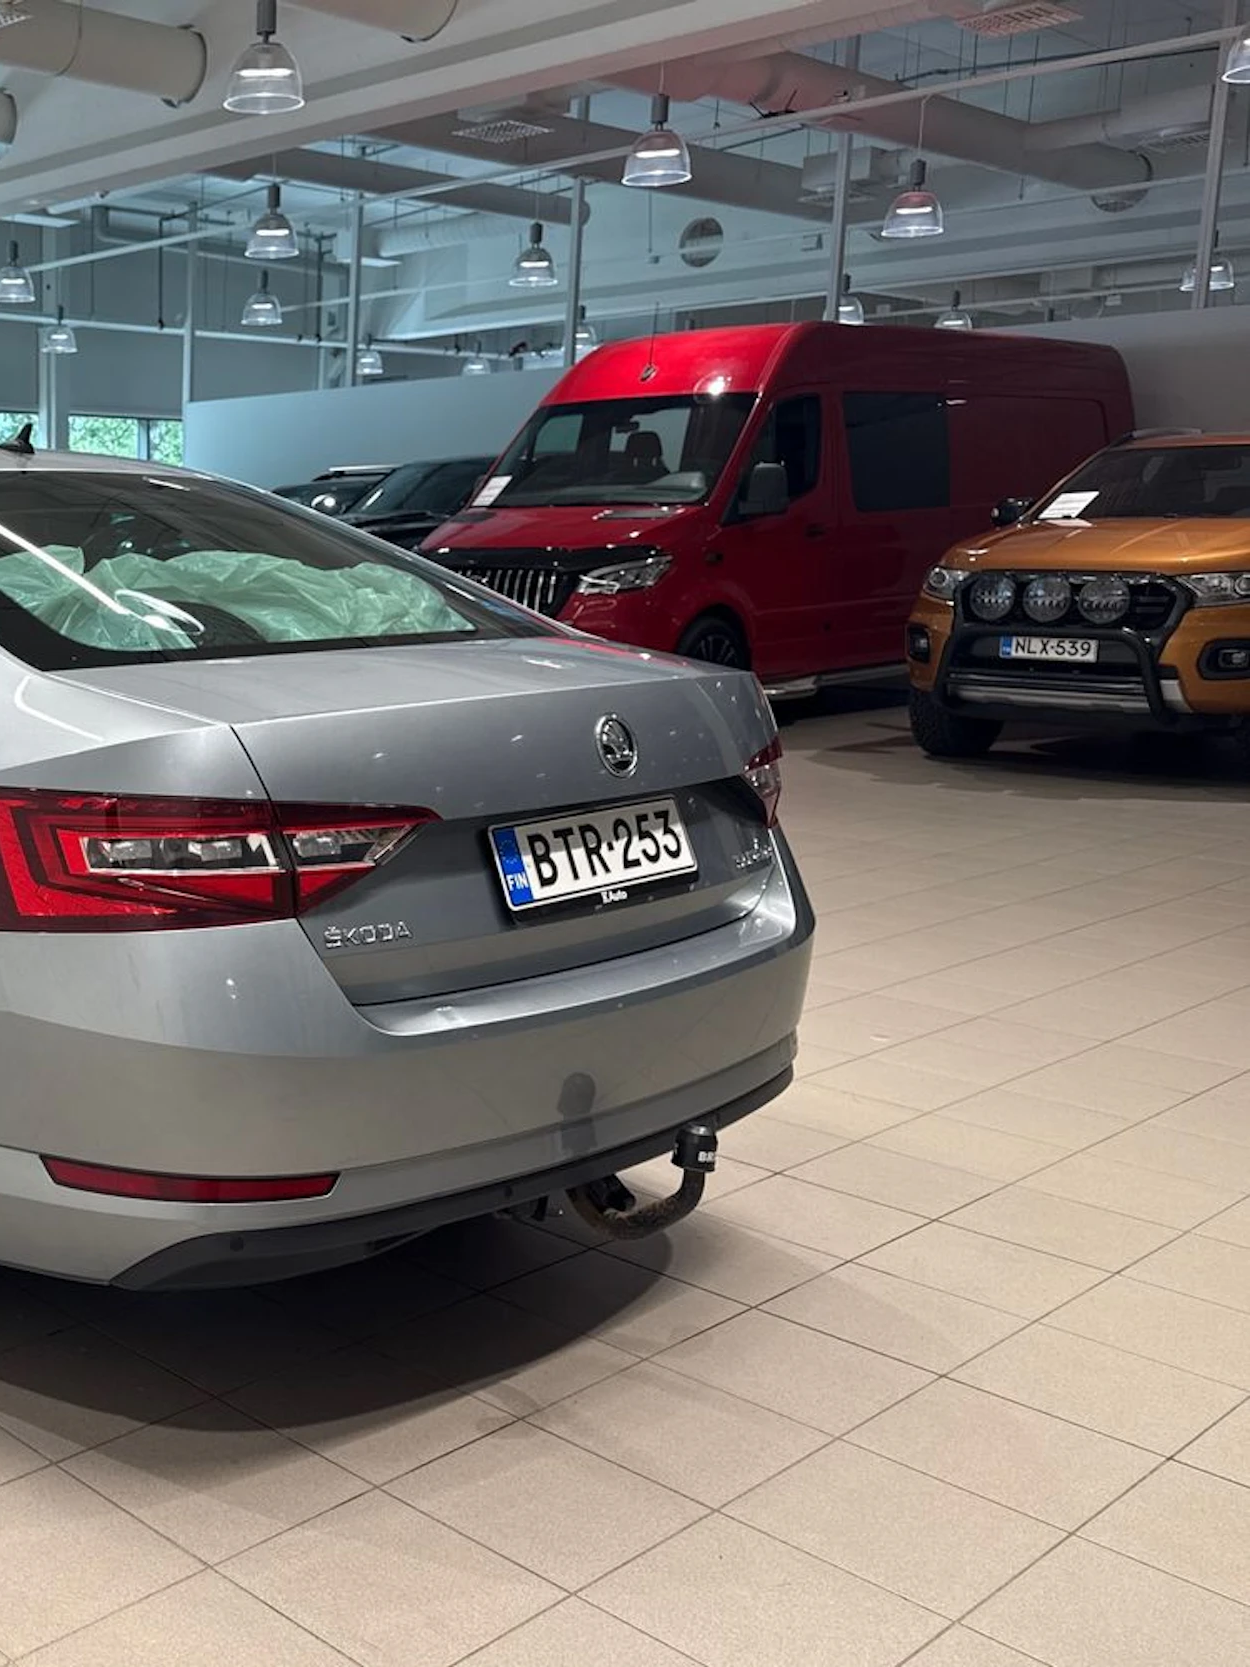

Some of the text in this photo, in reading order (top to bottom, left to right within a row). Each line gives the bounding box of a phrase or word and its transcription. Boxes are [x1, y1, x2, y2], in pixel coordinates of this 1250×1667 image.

[1014, 638, 1091, 657] NLX-539
[526, 809, 682, 888] BTR-253
[506, 873, 528, 890] FIN
[323, 920, 414, 949] ŠKODA
